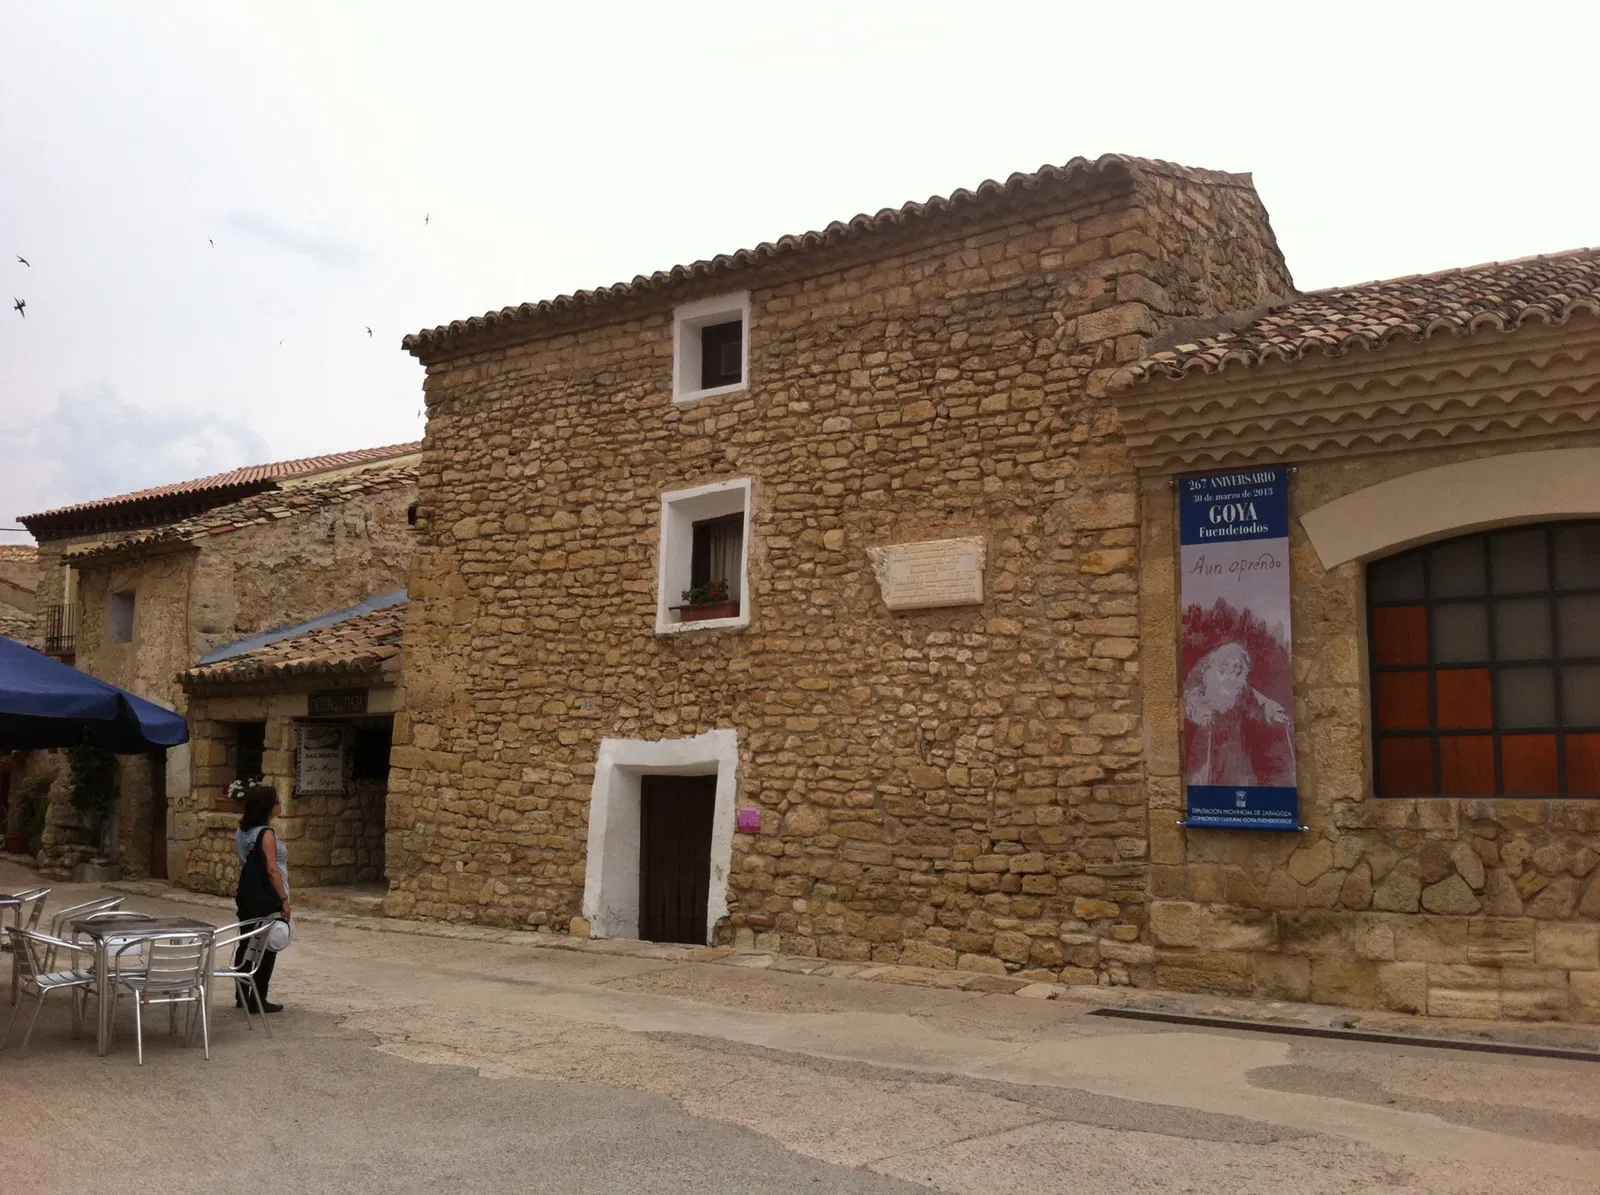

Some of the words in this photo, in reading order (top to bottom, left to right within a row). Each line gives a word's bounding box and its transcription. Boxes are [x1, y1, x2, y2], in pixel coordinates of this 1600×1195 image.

[1188, 479, 1207, 490] 267
[1210, 471, 1276, 488] ANIVERSARIO
[1193, 495, 1202, 503] 30
[1204, 494, 1212, 502] de
[1215, 493, 1240, 501] marzo
[1242, 490, 1251, 498] de
[1253, 487, 1273, 497] 2013
[1209, 502, 1258, 524] GOYA
[1200, 522, 1269, 537] Fuendetodos
[1229, 553, 1281, 582] aprendo
